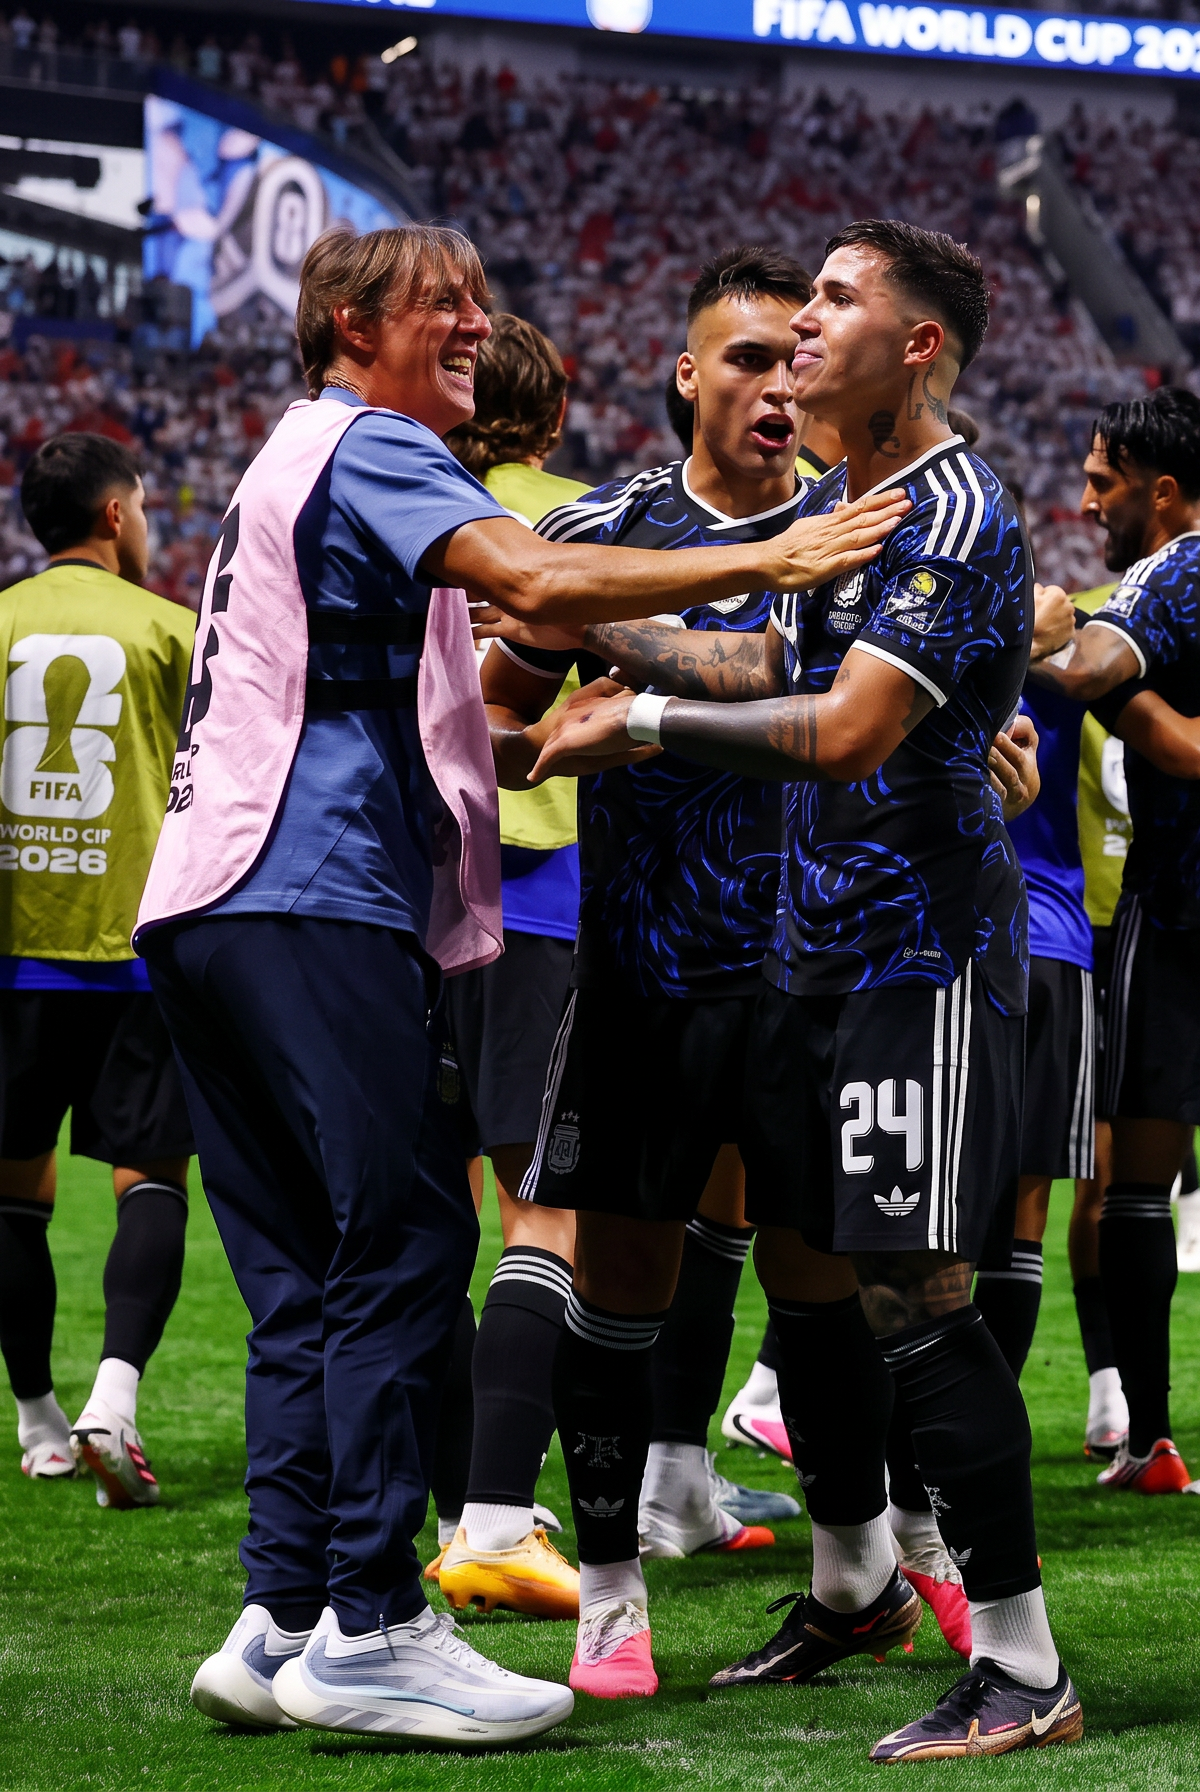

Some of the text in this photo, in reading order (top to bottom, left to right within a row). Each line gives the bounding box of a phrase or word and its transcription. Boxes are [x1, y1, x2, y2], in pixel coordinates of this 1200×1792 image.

[753, 0, 857, 44] FIFA
[858, 2, 1033, 58] WORLD
[1034, 18, 1132, 65] CUP
[29, 780, 82, 802] FIFA
[0, 823, 78, 843] WORLD
[0, 844, 107, 876] 2026
[839, 1078, 925, 1175] 24
